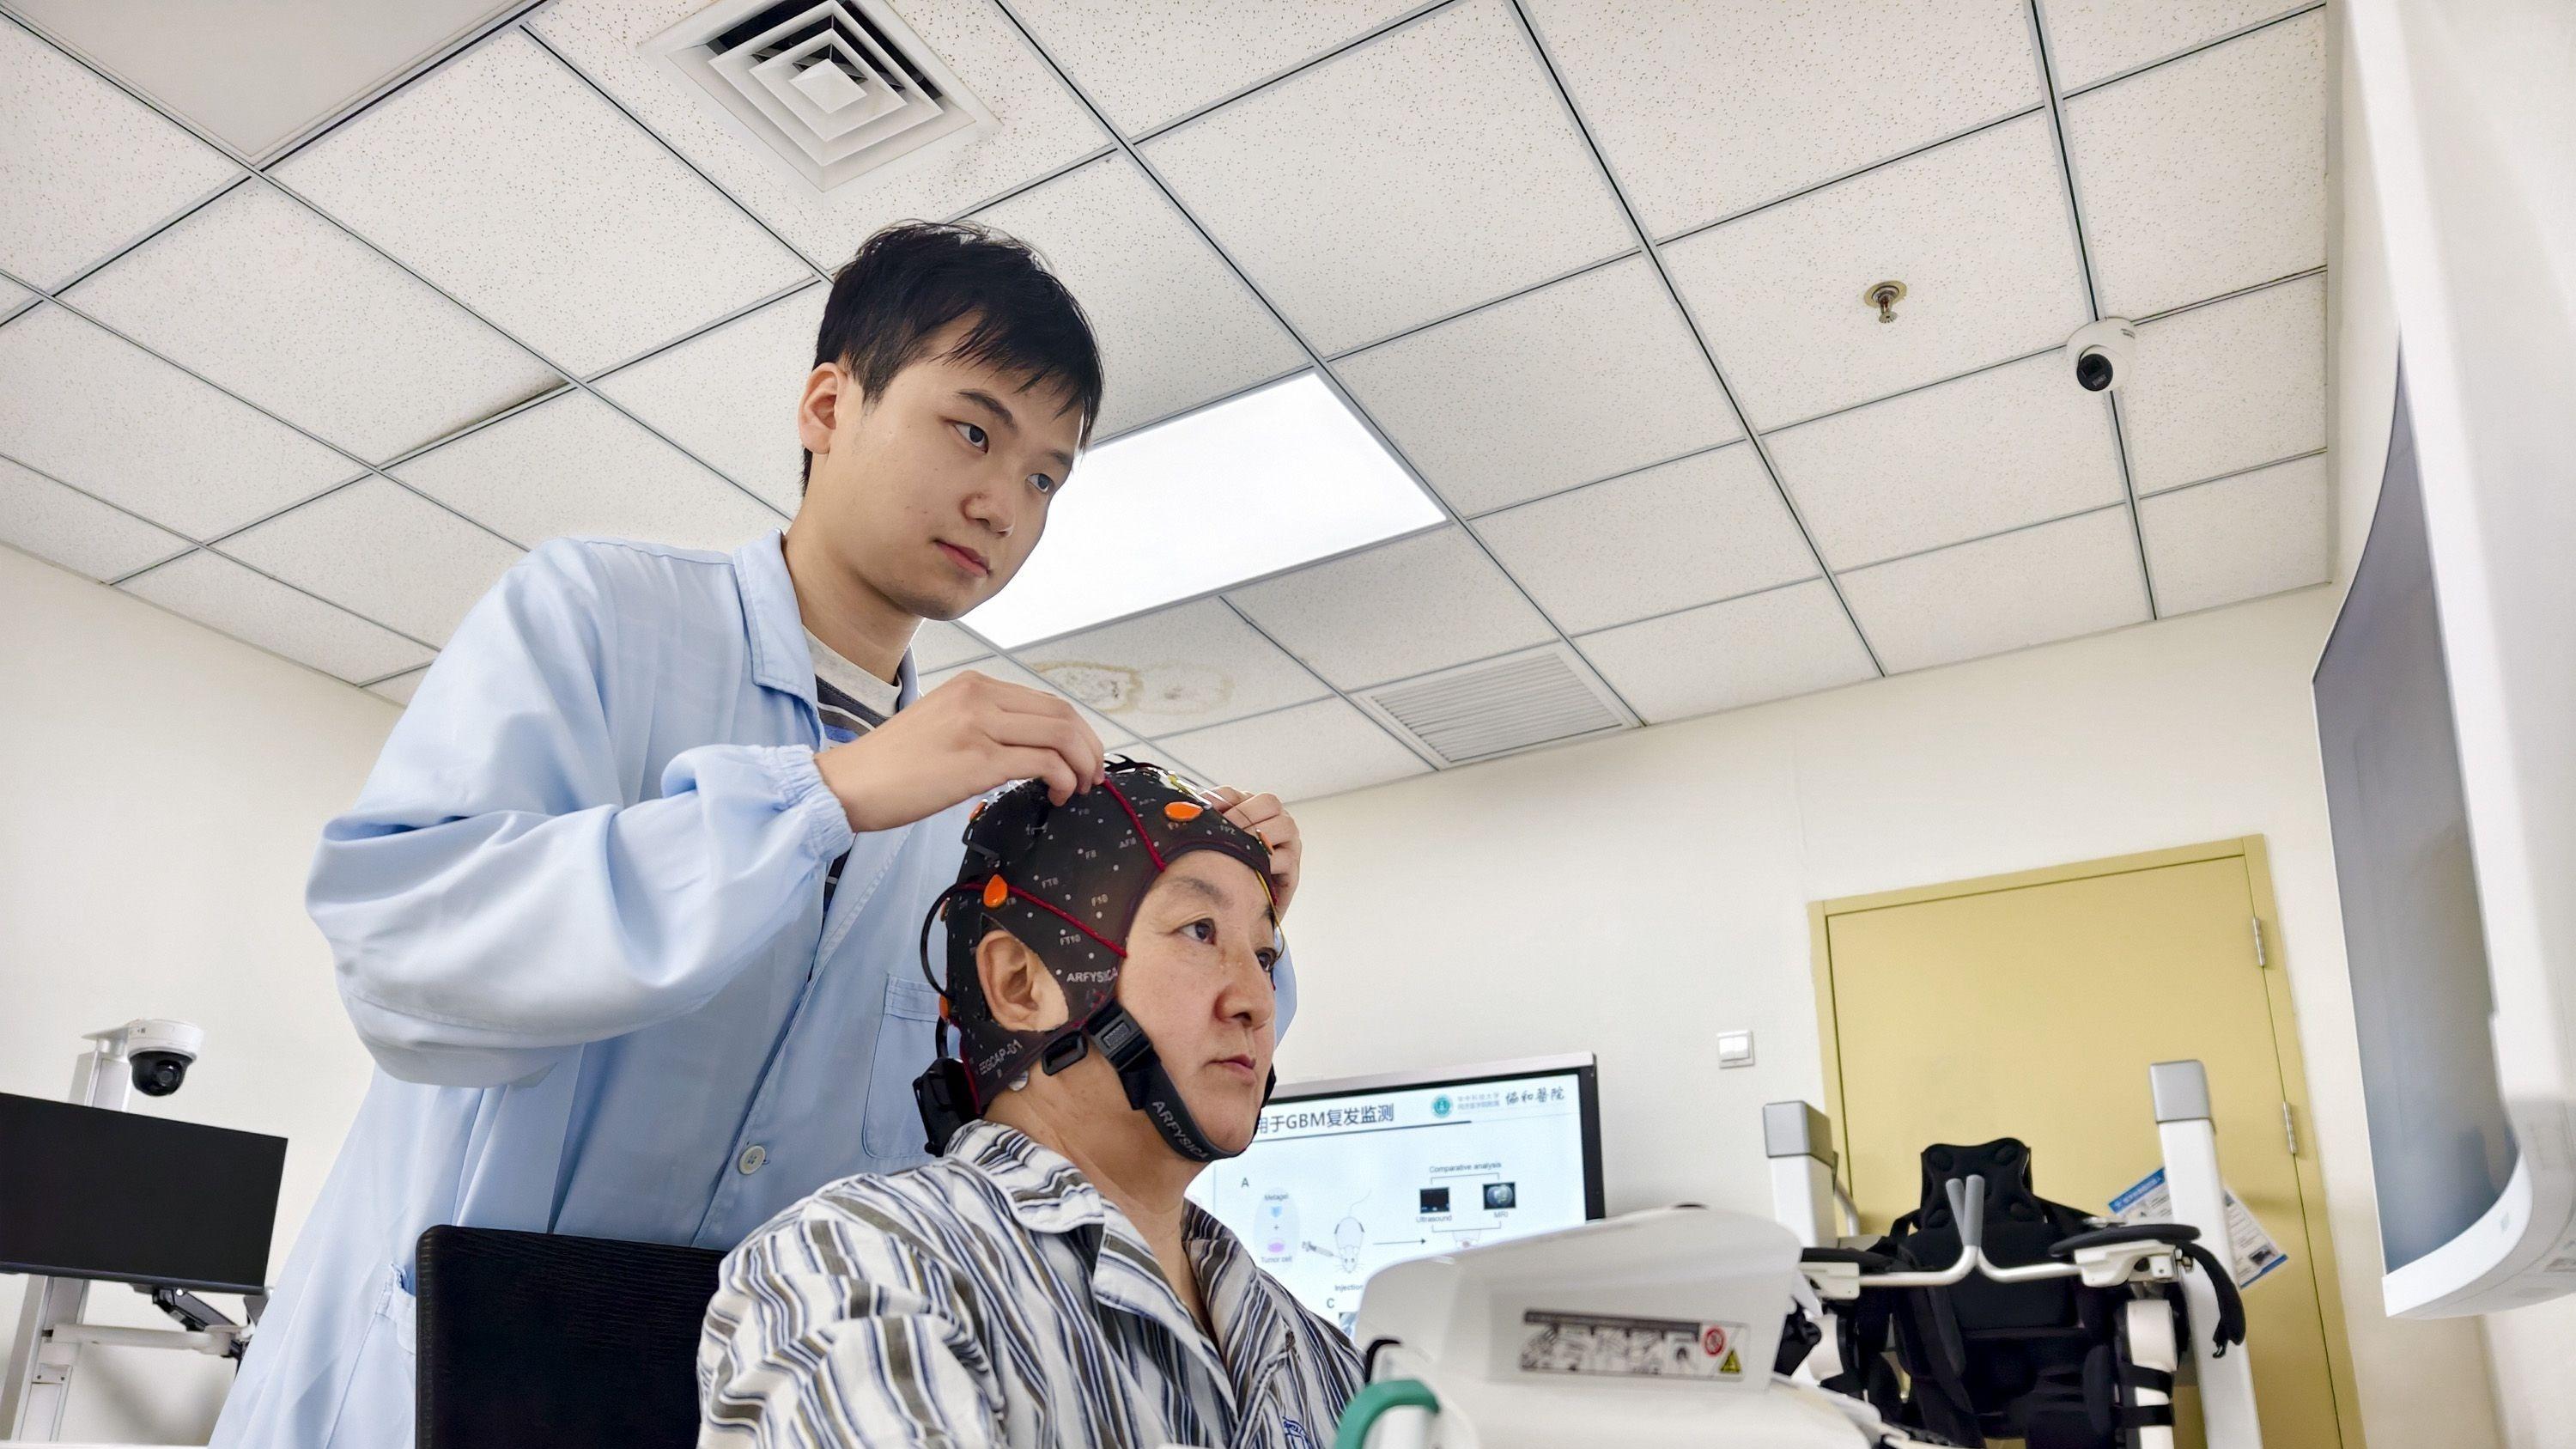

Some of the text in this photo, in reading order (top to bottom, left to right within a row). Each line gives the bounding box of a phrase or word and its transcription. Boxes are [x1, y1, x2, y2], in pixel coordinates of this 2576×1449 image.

[1257, 1103, 1394, 1135] 用于GBM复发监测
[1429, 1161, 1502, 1173] Comparative analysis
[1241, 1177, 1249, 1188] A
[1416, 1215, 1453, 1223] Ultrasound
[1326, 1298, 1335, 1309] C
